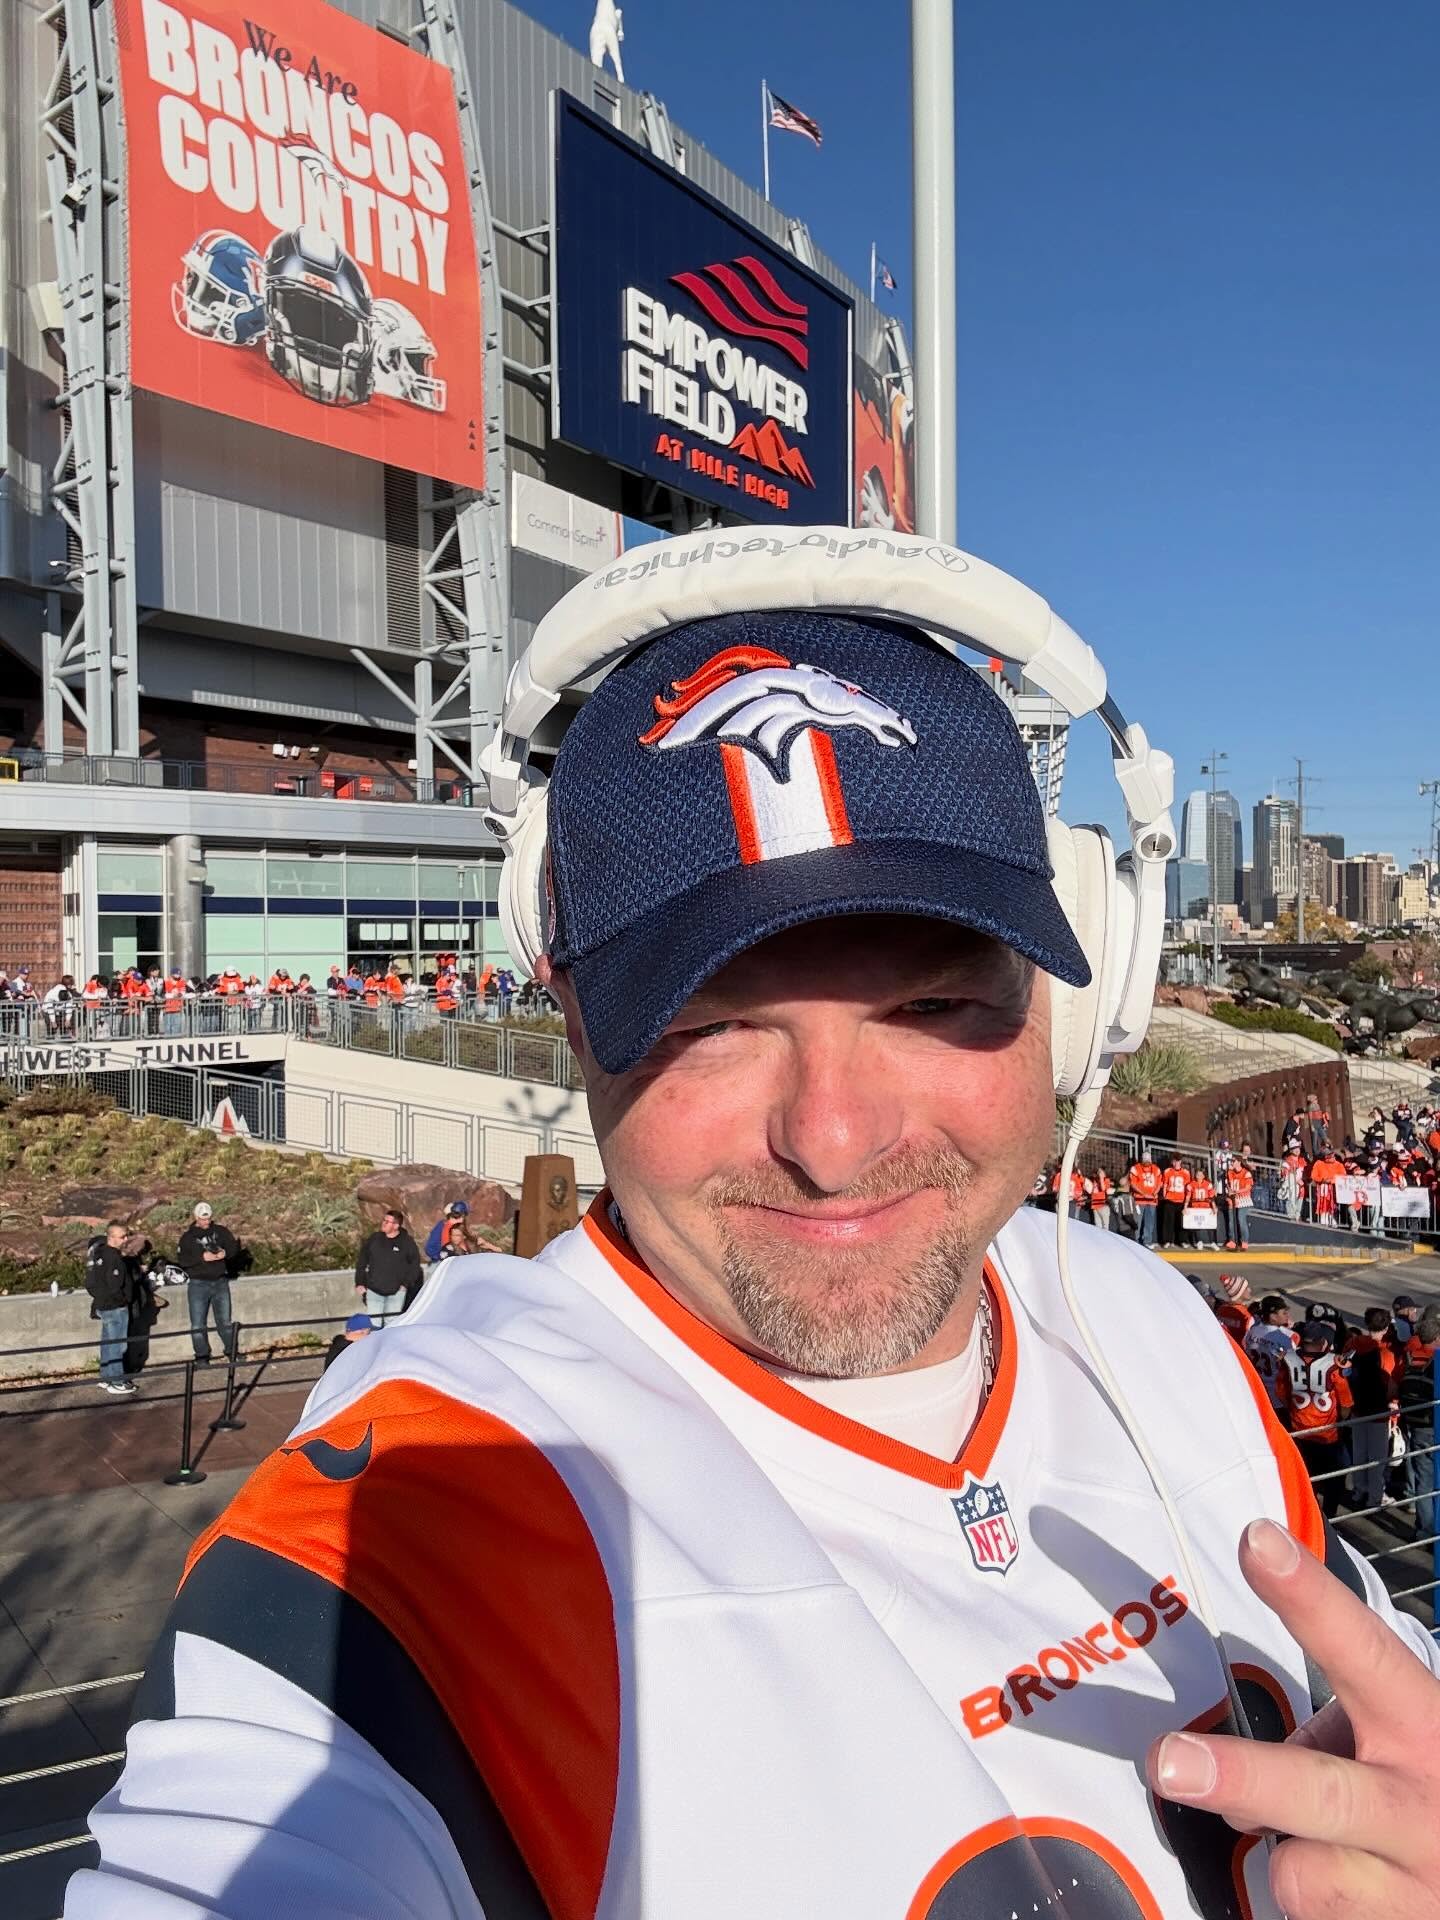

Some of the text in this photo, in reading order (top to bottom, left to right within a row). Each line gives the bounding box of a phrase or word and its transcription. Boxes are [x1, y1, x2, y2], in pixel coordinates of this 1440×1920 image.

[141, 0, 449, 214] BRONCOS
[242, 18, 359, 106] We Are
[158, 94, 448, 295] COUNTRY
[624, 286, 808, 435] EMPOWER
[624, 348, 736, 446] FIELD
[656, 433, 789, 510] AT MILE HIGH
[136, 1041, 249, 1065] TUNNEL
[968, 1515, 1018, 1563] NFL
[959, 1574, 1189, 1740] BRONCOS
